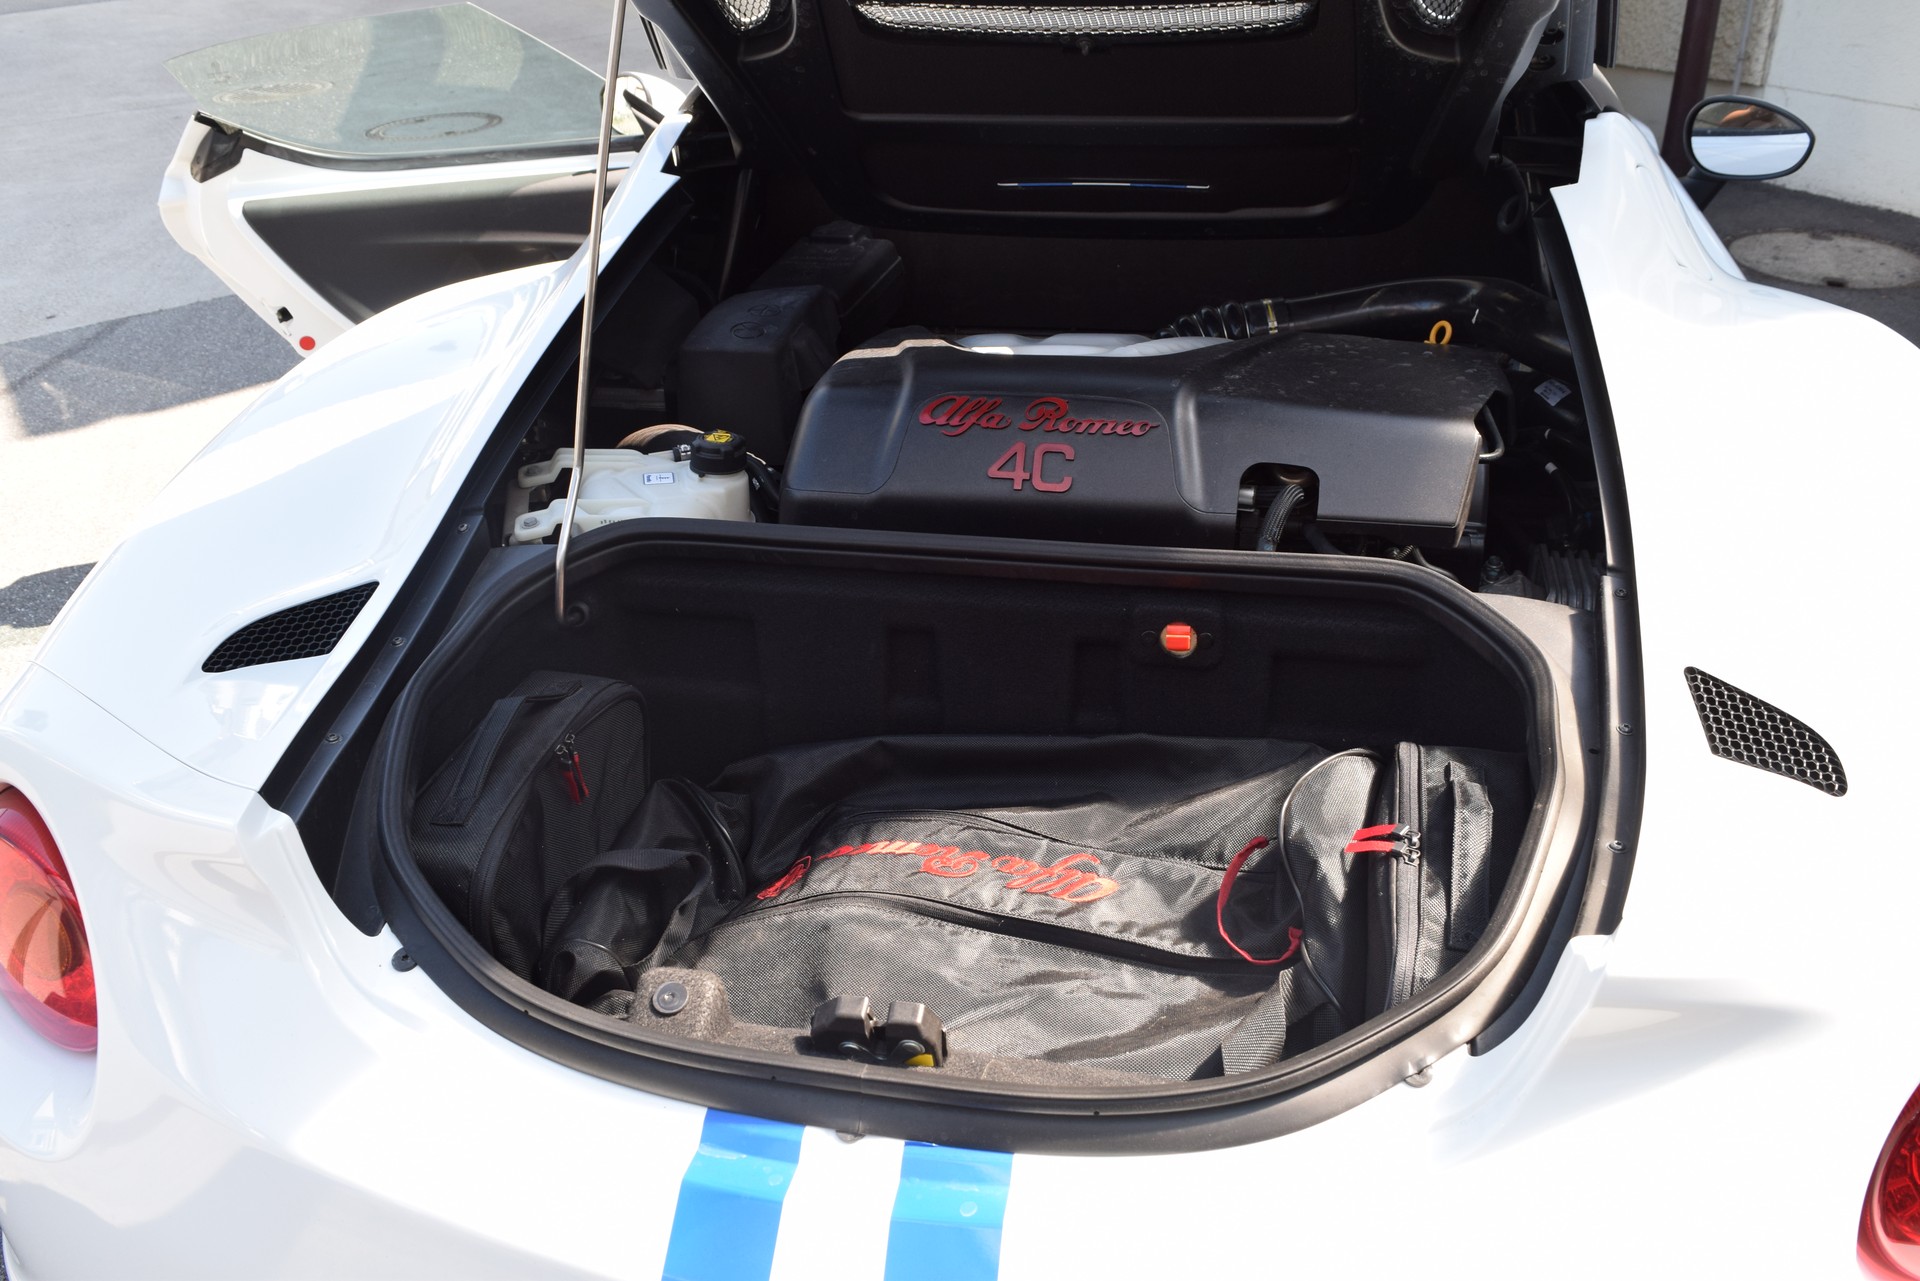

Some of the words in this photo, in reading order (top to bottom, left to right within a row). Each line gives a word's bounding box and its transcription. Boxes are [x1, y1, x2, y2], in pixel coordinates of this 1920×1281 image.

[919, 395, 1012, 437] Alfa
[1018, 396, 1159, 437] Romeo
[987, 441, 1076, 493] 4C
[993, 853, 1119, 902] Alfa
